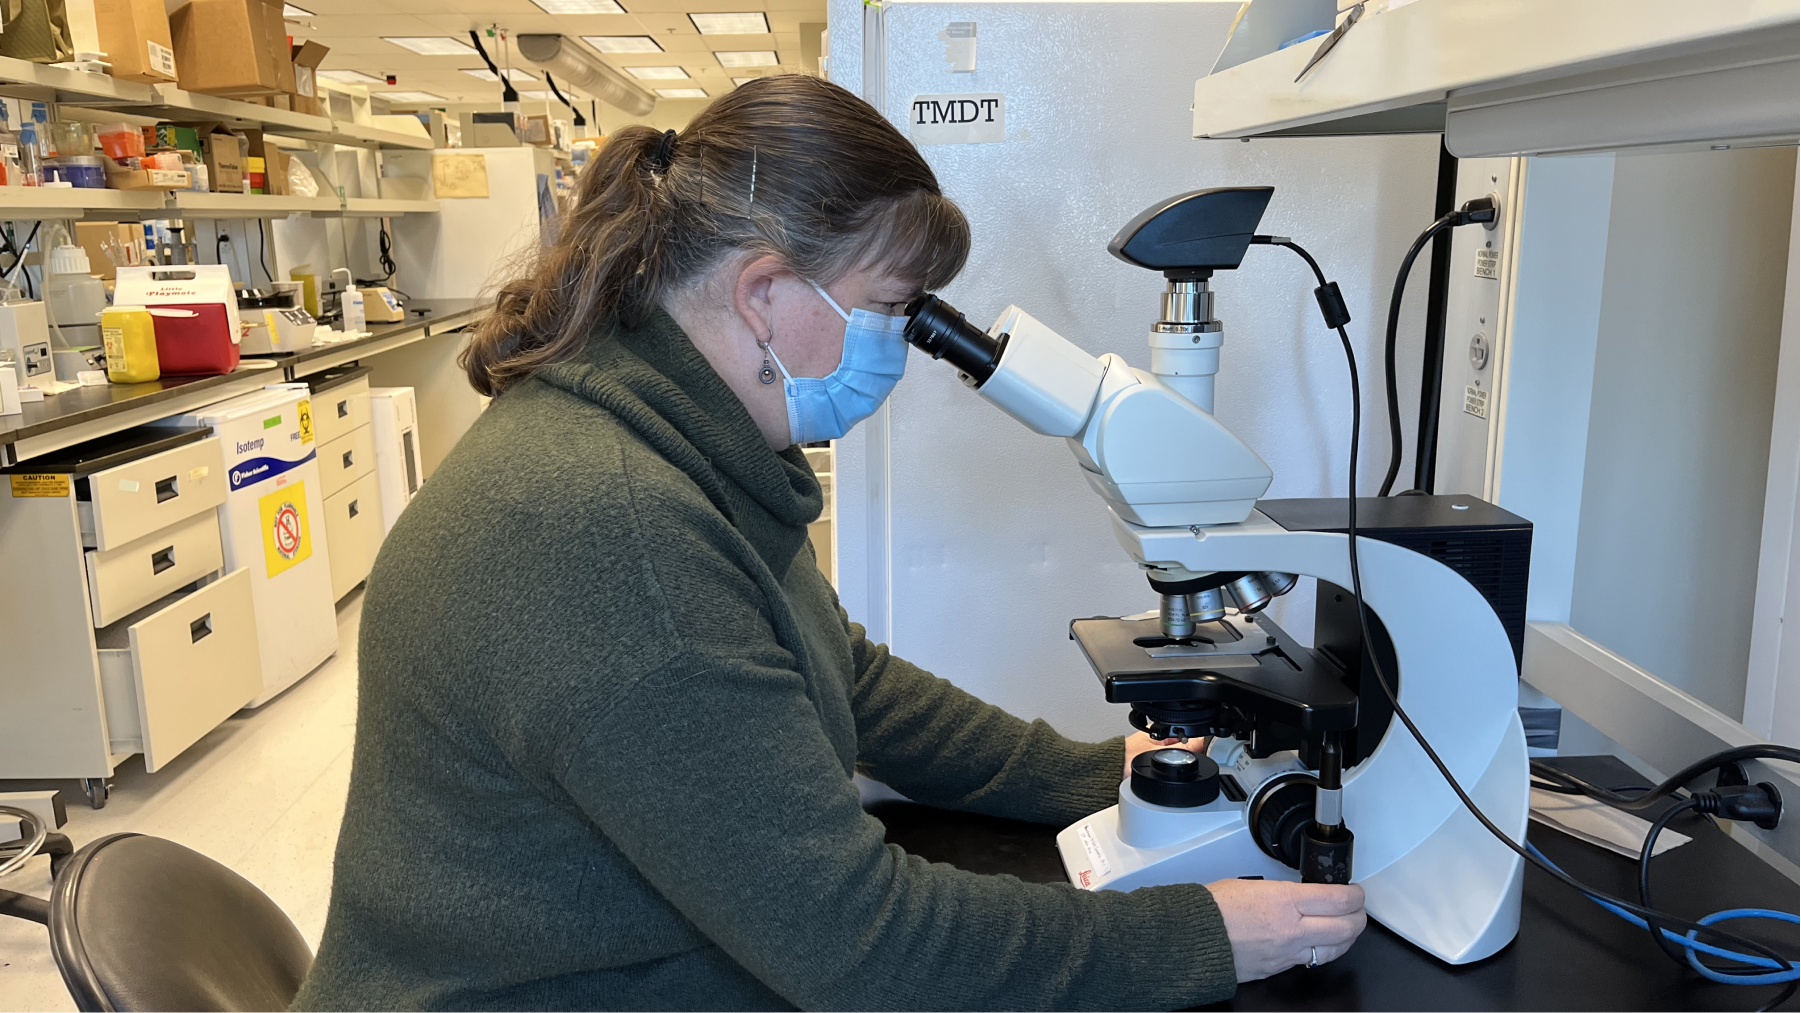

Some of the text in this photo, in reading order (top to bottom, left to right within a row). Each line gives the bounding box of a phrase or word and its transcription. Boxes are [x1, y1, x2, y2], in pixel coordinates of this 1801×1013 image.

[913, 99, 998, 124] TMDT
[1476, 267, 1492, 276] BENCH
[1466, 404, 1480, 414] BENCH
[236, 438, 264, 455] Isotemp
[241, 464, 269, 479] Fisher Scientific
[1079, 870, 1092, 888] Leica
